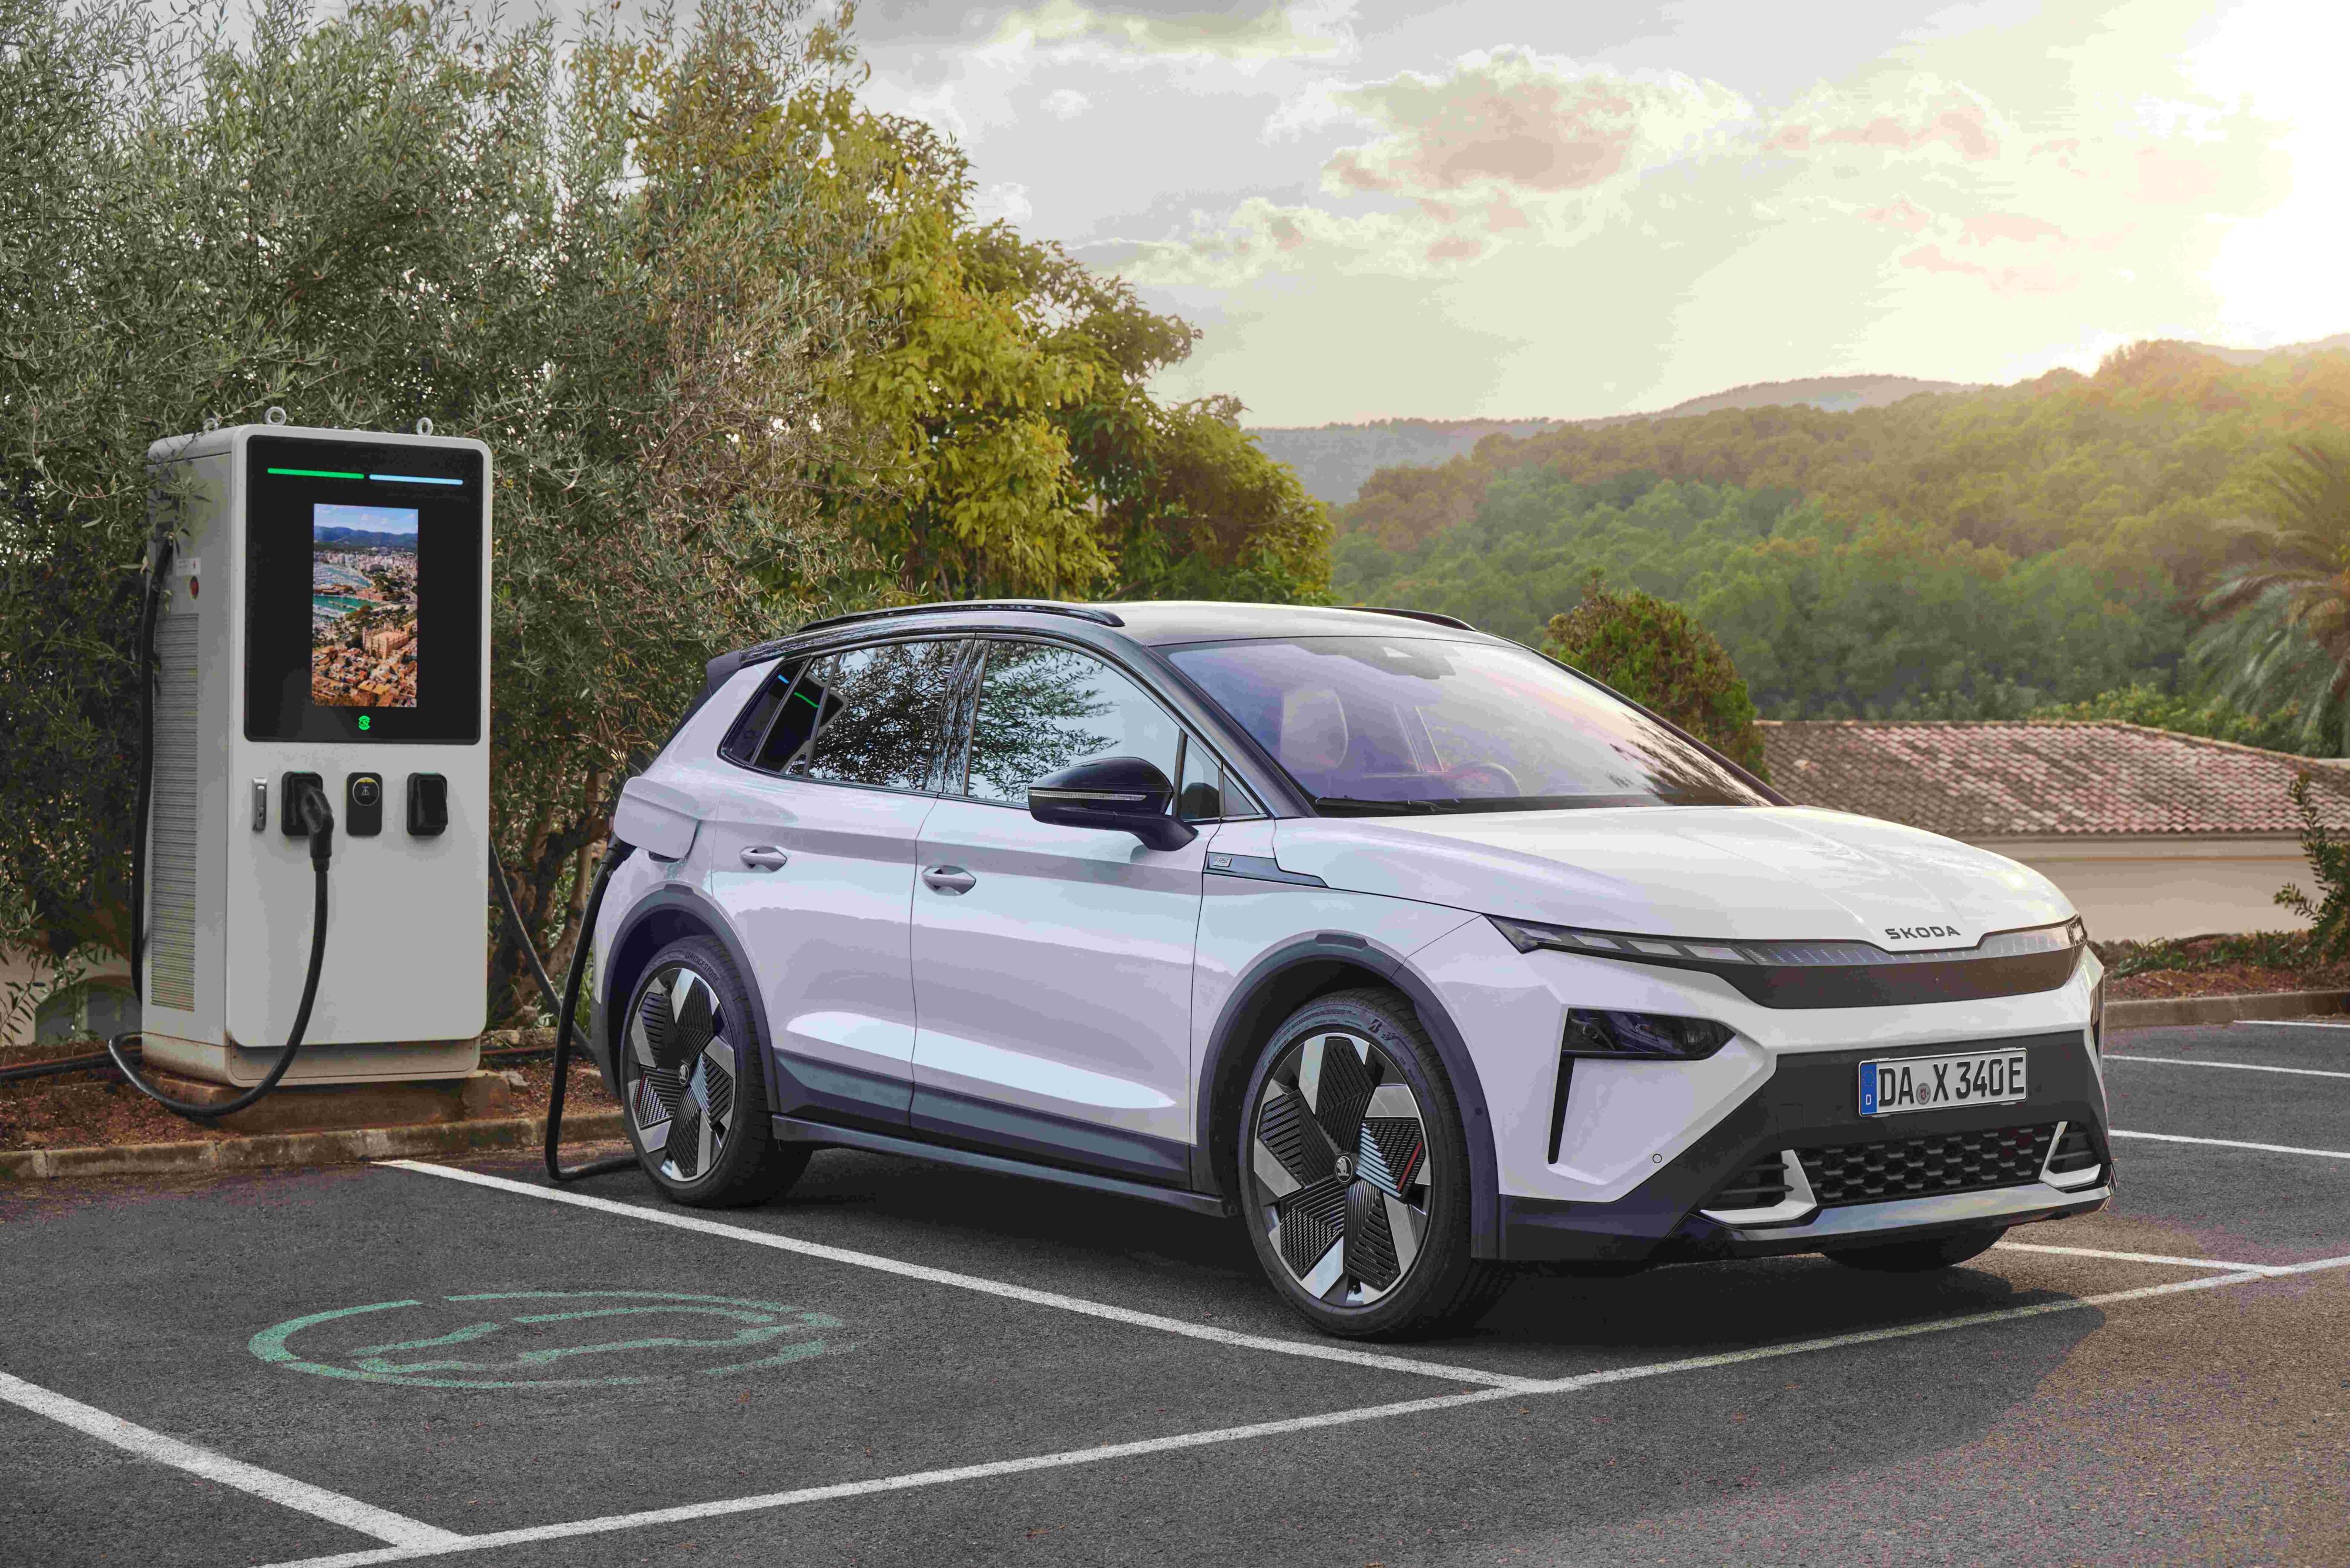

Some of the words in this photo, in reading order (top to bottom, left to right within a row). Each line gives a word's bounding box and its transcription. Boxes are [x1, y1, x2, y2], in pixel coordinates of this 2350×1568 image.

[1885, 926, 1961, 939] SKODA
[685, 951, 720, 983] BRIDGESTONE
[1879, 1066, 1914, 1106] DA
[1933, 1063, 1949, 1102] X
[1865, 1094, 1872, 1105] D
